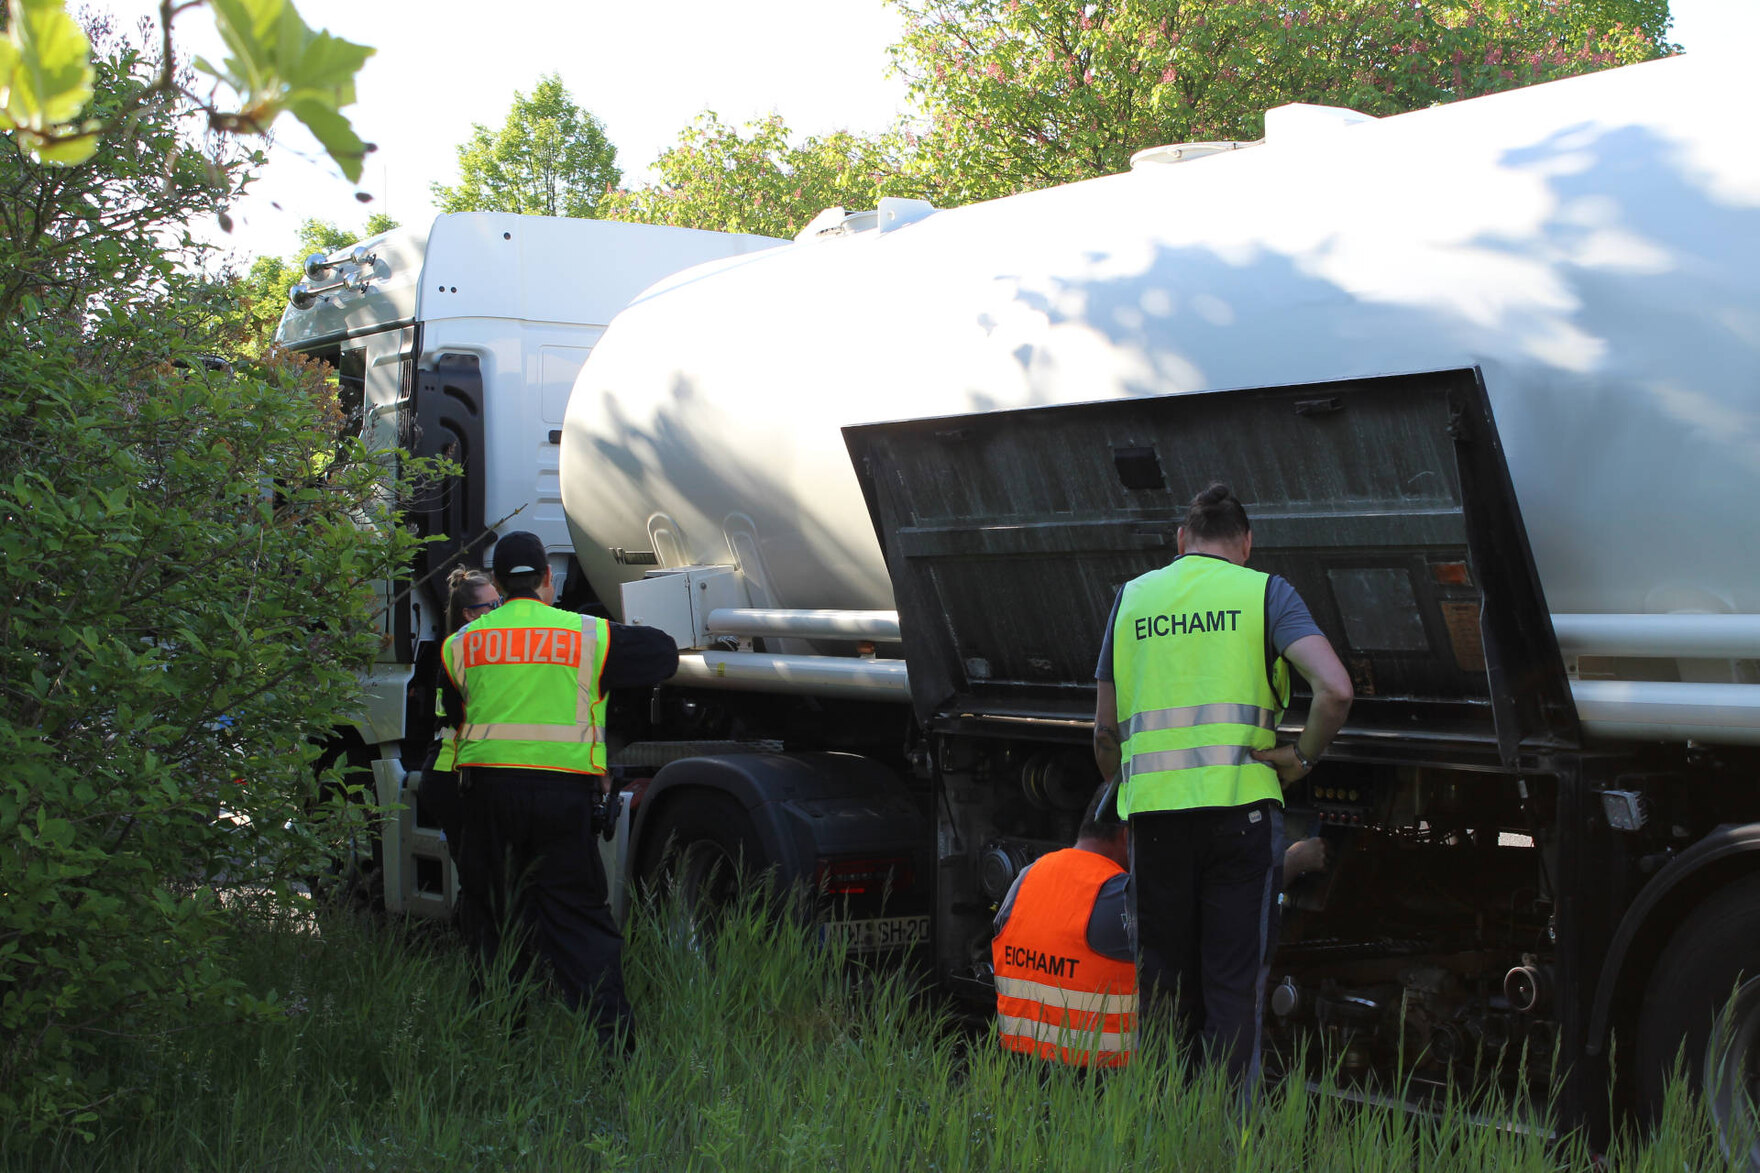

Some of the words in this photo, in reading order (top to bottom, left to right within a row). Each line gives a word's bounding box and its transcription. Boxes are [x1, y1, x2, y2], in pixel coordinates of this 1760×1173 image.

[1134, 609, 1242, 641] EICHAMT
[468, 629, 576, 665] POLIZEI
[1004, 945, 1081, 979] EICHAMT
